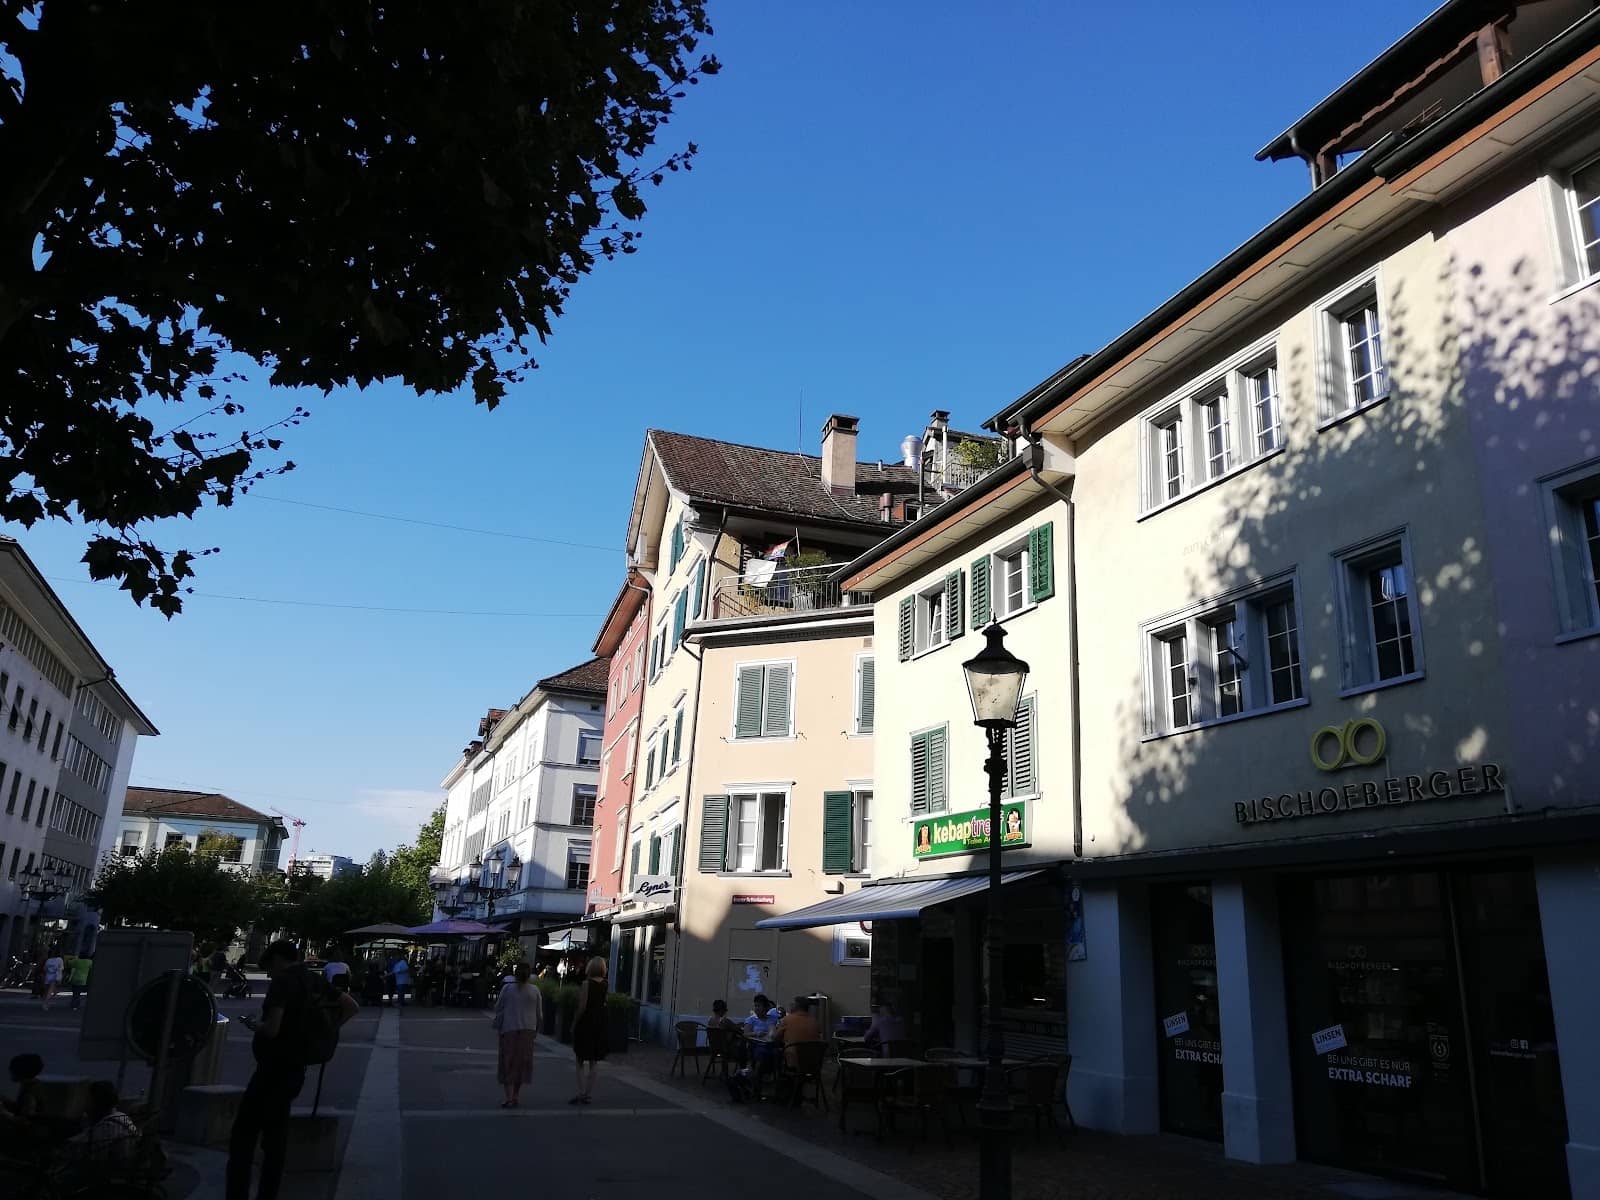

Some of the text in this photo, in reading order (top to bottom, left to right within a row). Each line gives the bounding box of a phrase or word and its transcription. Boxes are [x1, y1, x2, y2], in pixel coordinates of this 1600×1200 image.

[1234, 763, 1505, 824] BISCHOFBERGER
[933, 810, 1004, 845] kebaptre
[1315, 1029, 1342, 1044] LINSEN
[1175, 1049, 1201, 1062] EXTRA
[1327, 1054, 1410, 1071] BEI UNS GIBT ES NUR
[1327, 1067, 1412, 1088] EXTRA SCHARF
